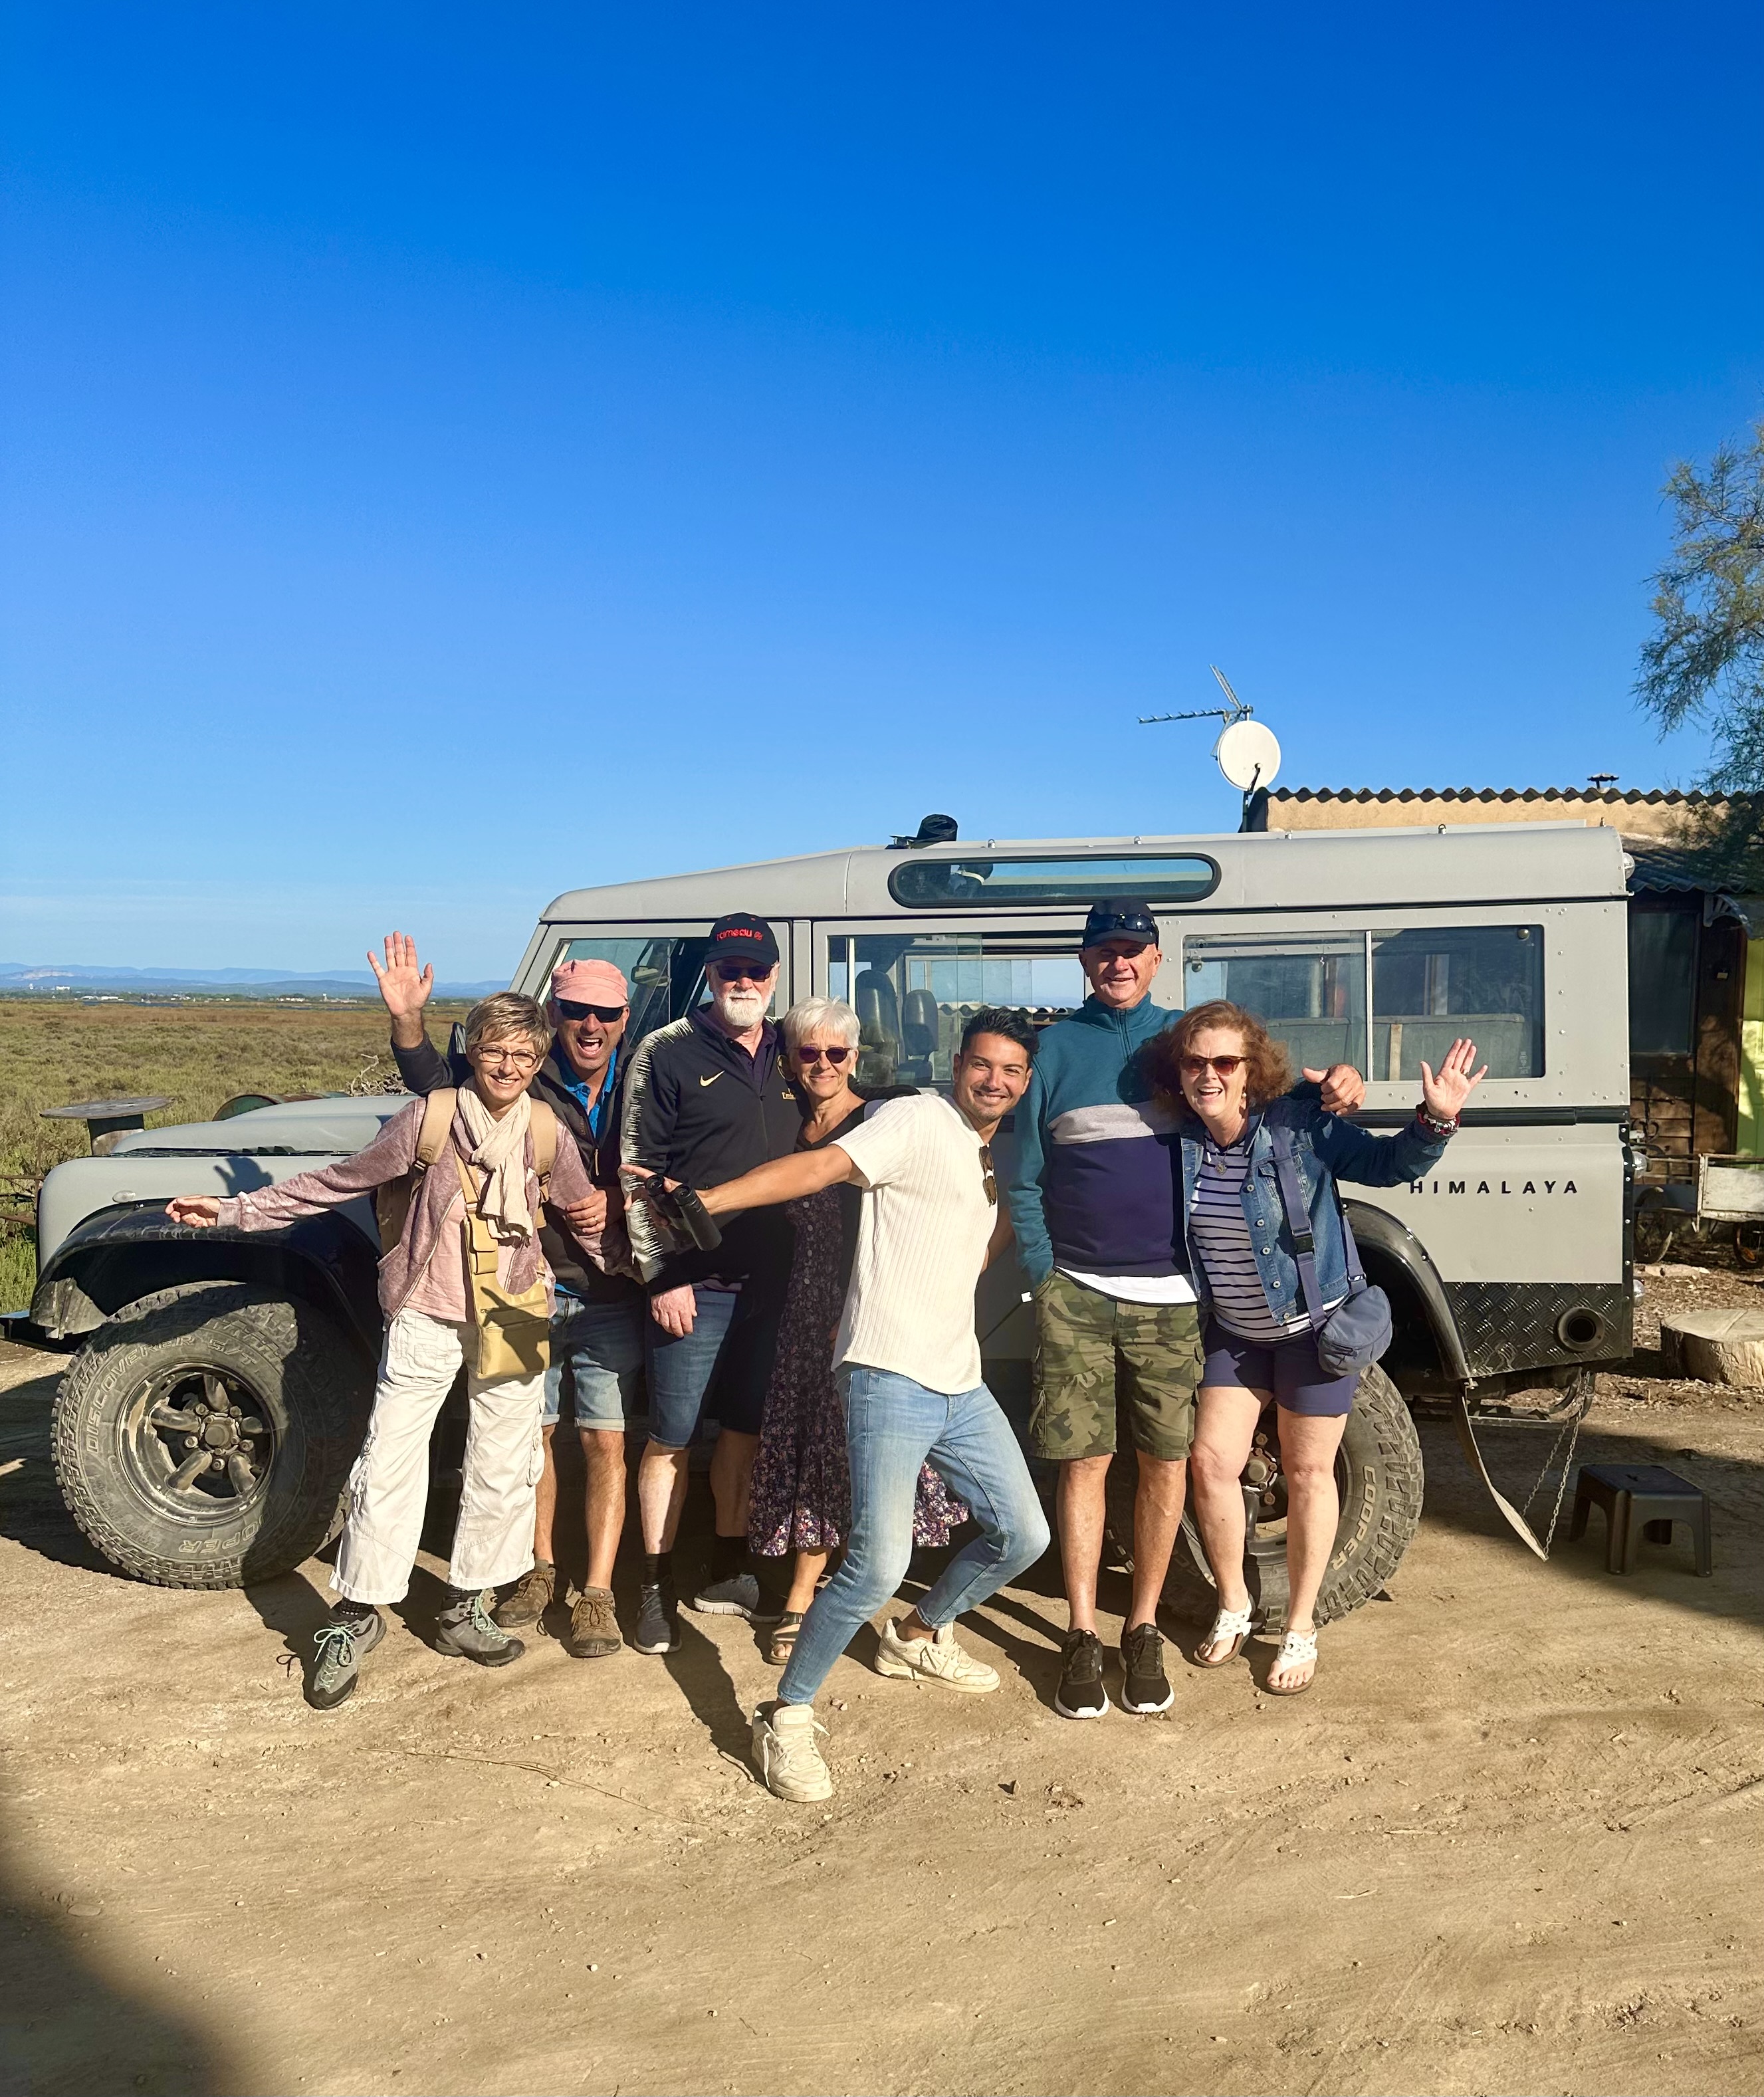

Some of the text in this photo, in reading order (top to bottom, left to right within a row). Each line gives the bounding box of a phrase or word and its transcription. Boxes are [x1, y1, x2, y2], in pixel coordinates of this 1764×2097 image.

[1409, 1180, 1578, 1194] HIMALAYA
[207, 1339, 257, 1365] S/T
[1330, 1465, 1377, 1571] COOPER
